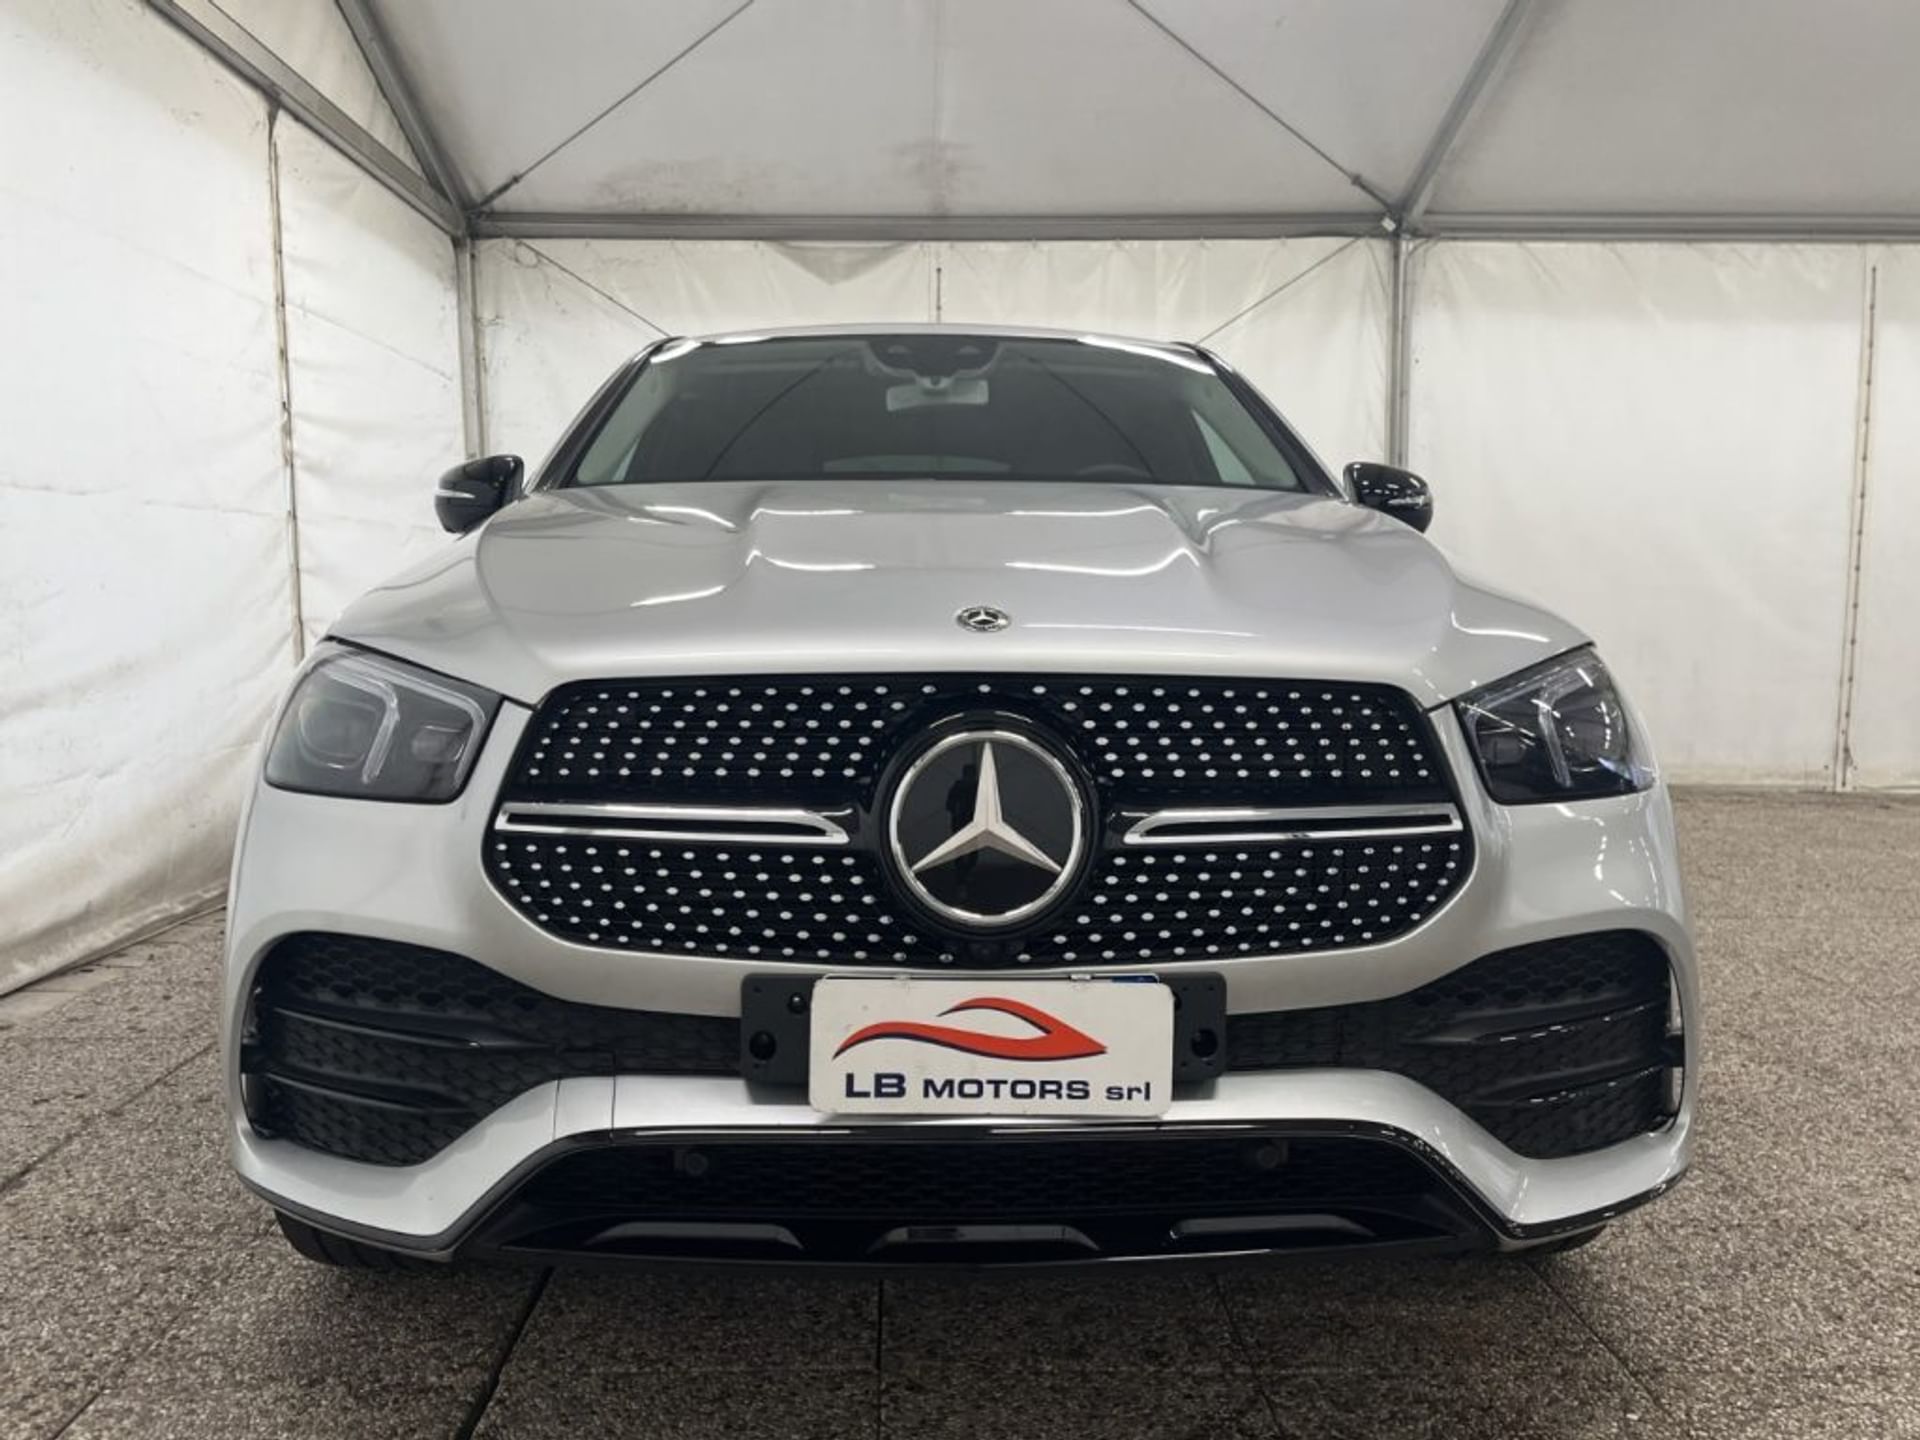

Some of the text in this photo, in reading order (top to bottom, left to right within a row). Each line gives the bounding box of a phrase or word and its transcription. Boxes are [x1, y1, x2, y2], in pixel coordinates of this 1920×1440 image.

[845, 1072, 1151, 1101] LB MOTORS srl
